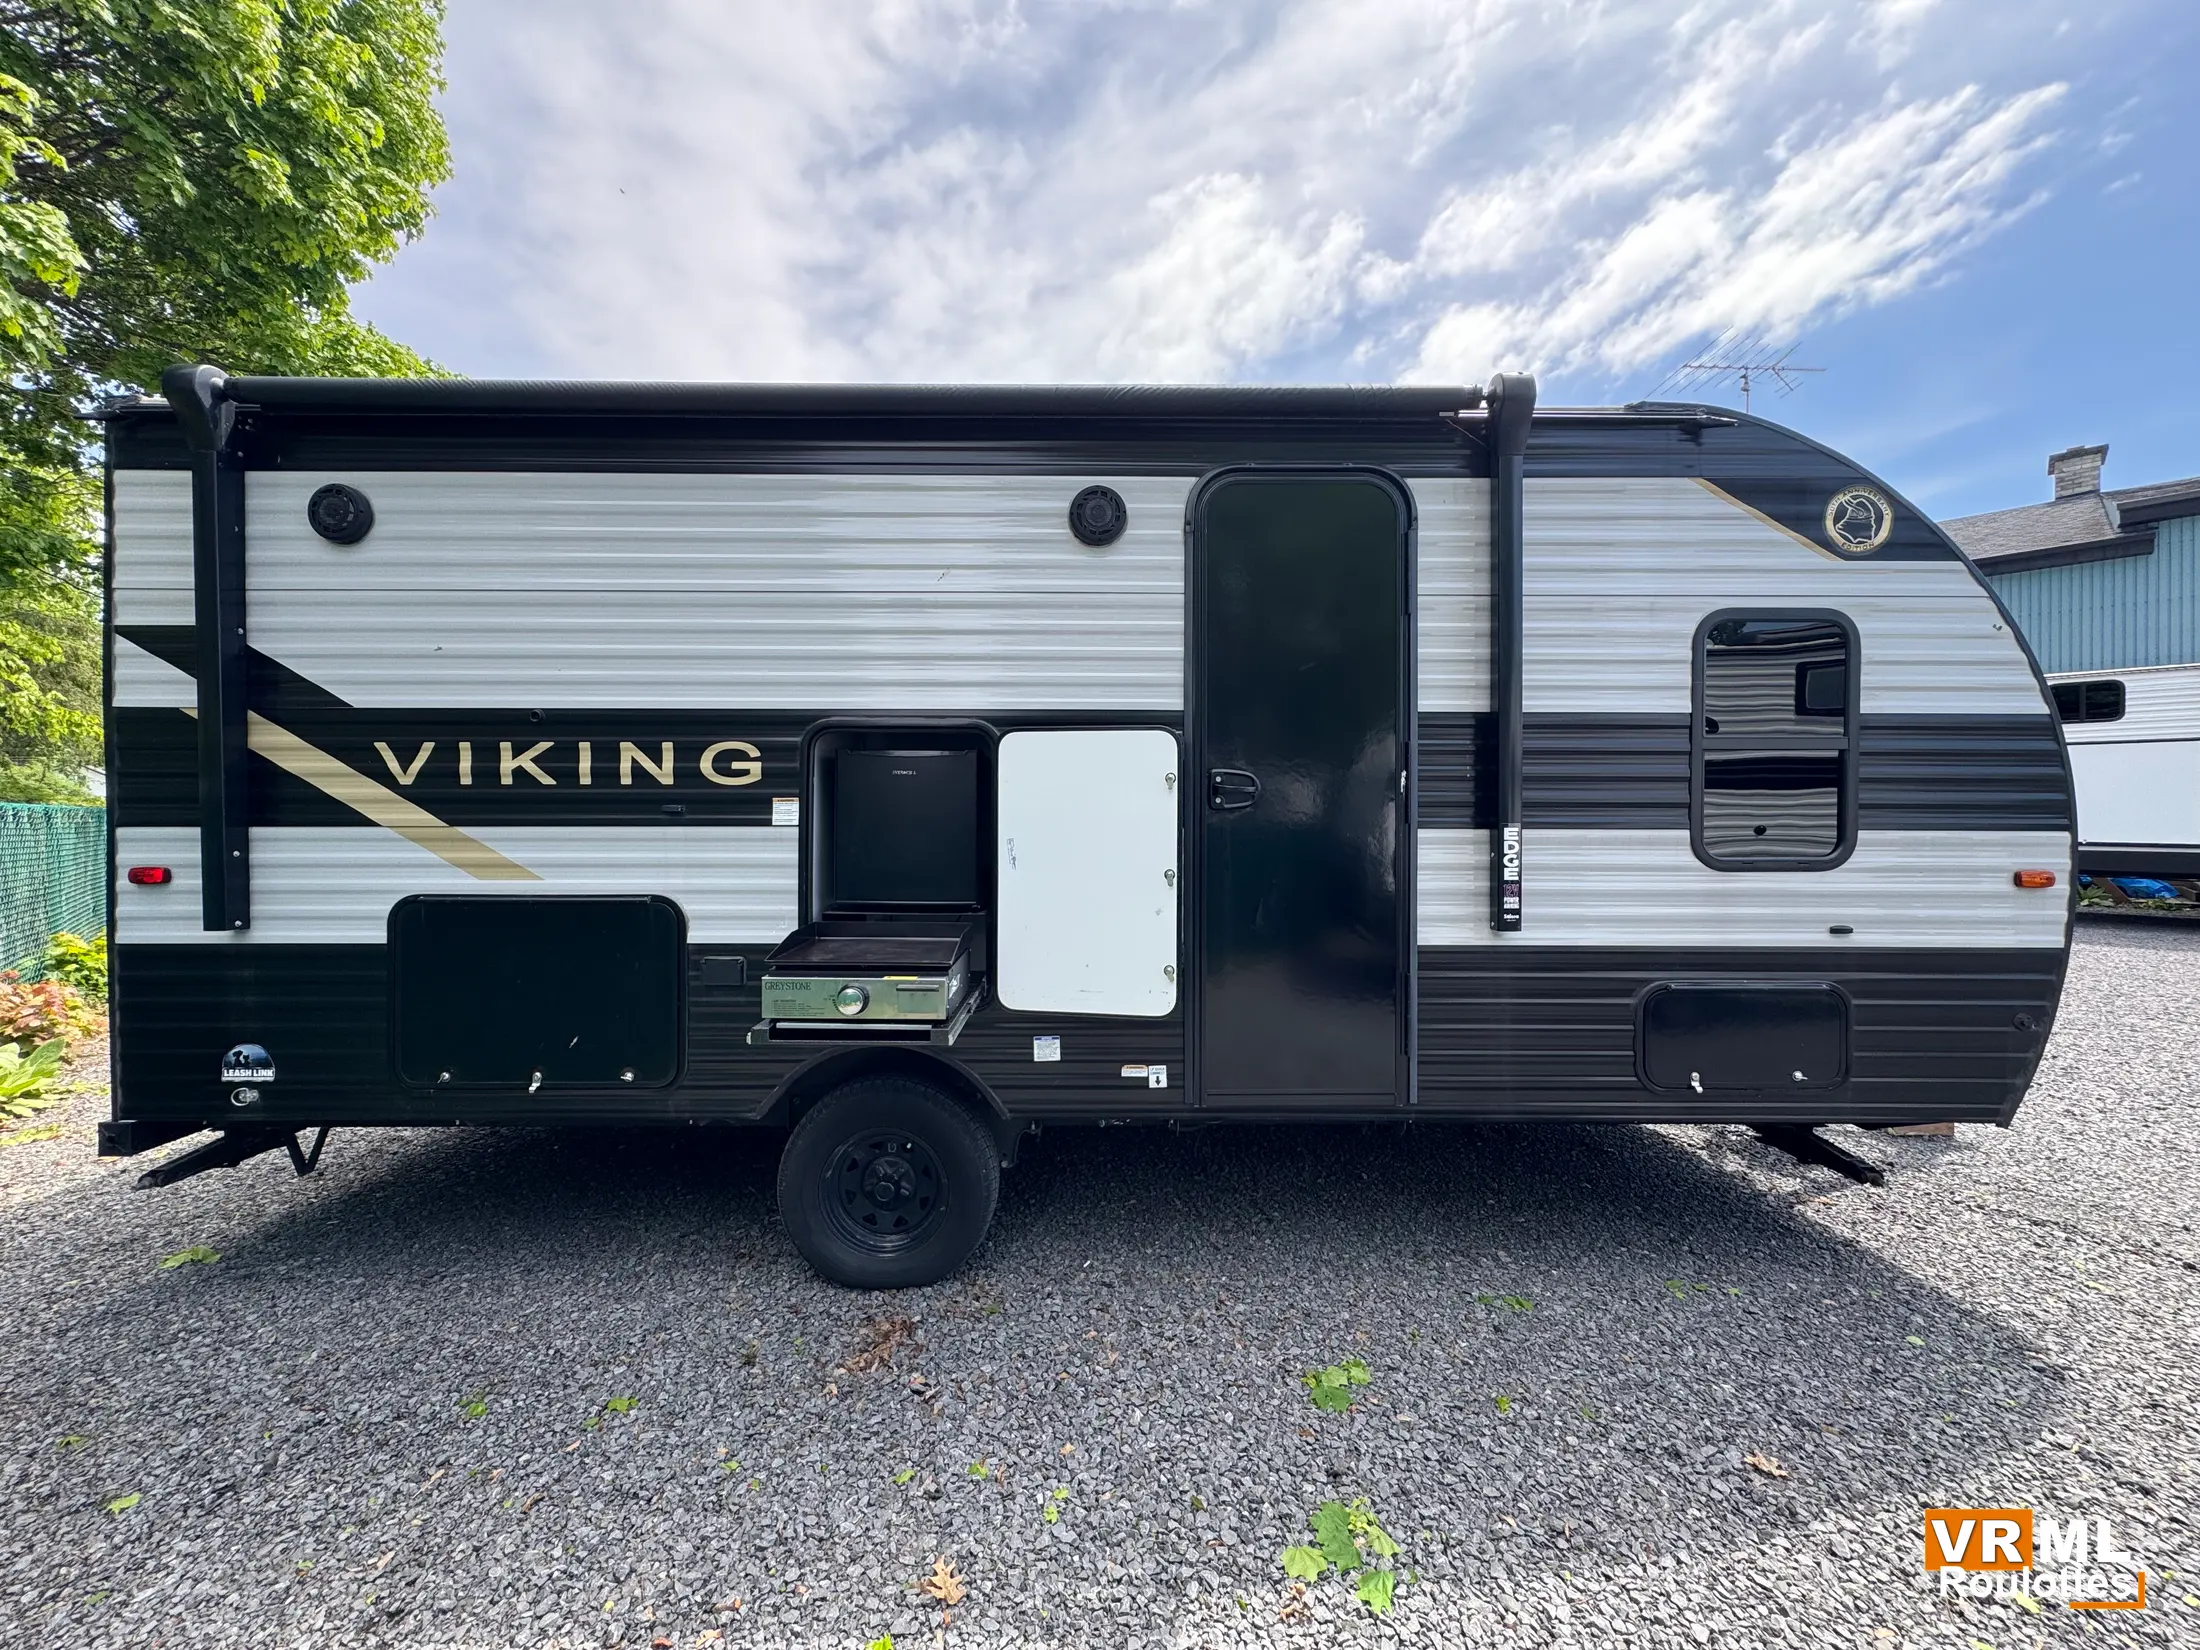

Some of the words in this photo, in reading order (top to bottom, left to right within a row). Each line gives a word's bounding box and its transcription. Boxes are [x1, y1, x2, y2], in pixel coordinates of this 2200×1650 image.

[1841, 542, 1875, 551] EDITION
[373, 741, 763, 786] VIKING
[1503, 827, 1520, 880] EDGE
[764, 981, 812, 991] GREYSTONE
[223, 1069, 252, 1077] LEASH
[253, 1069, 274, 1077] LINK
